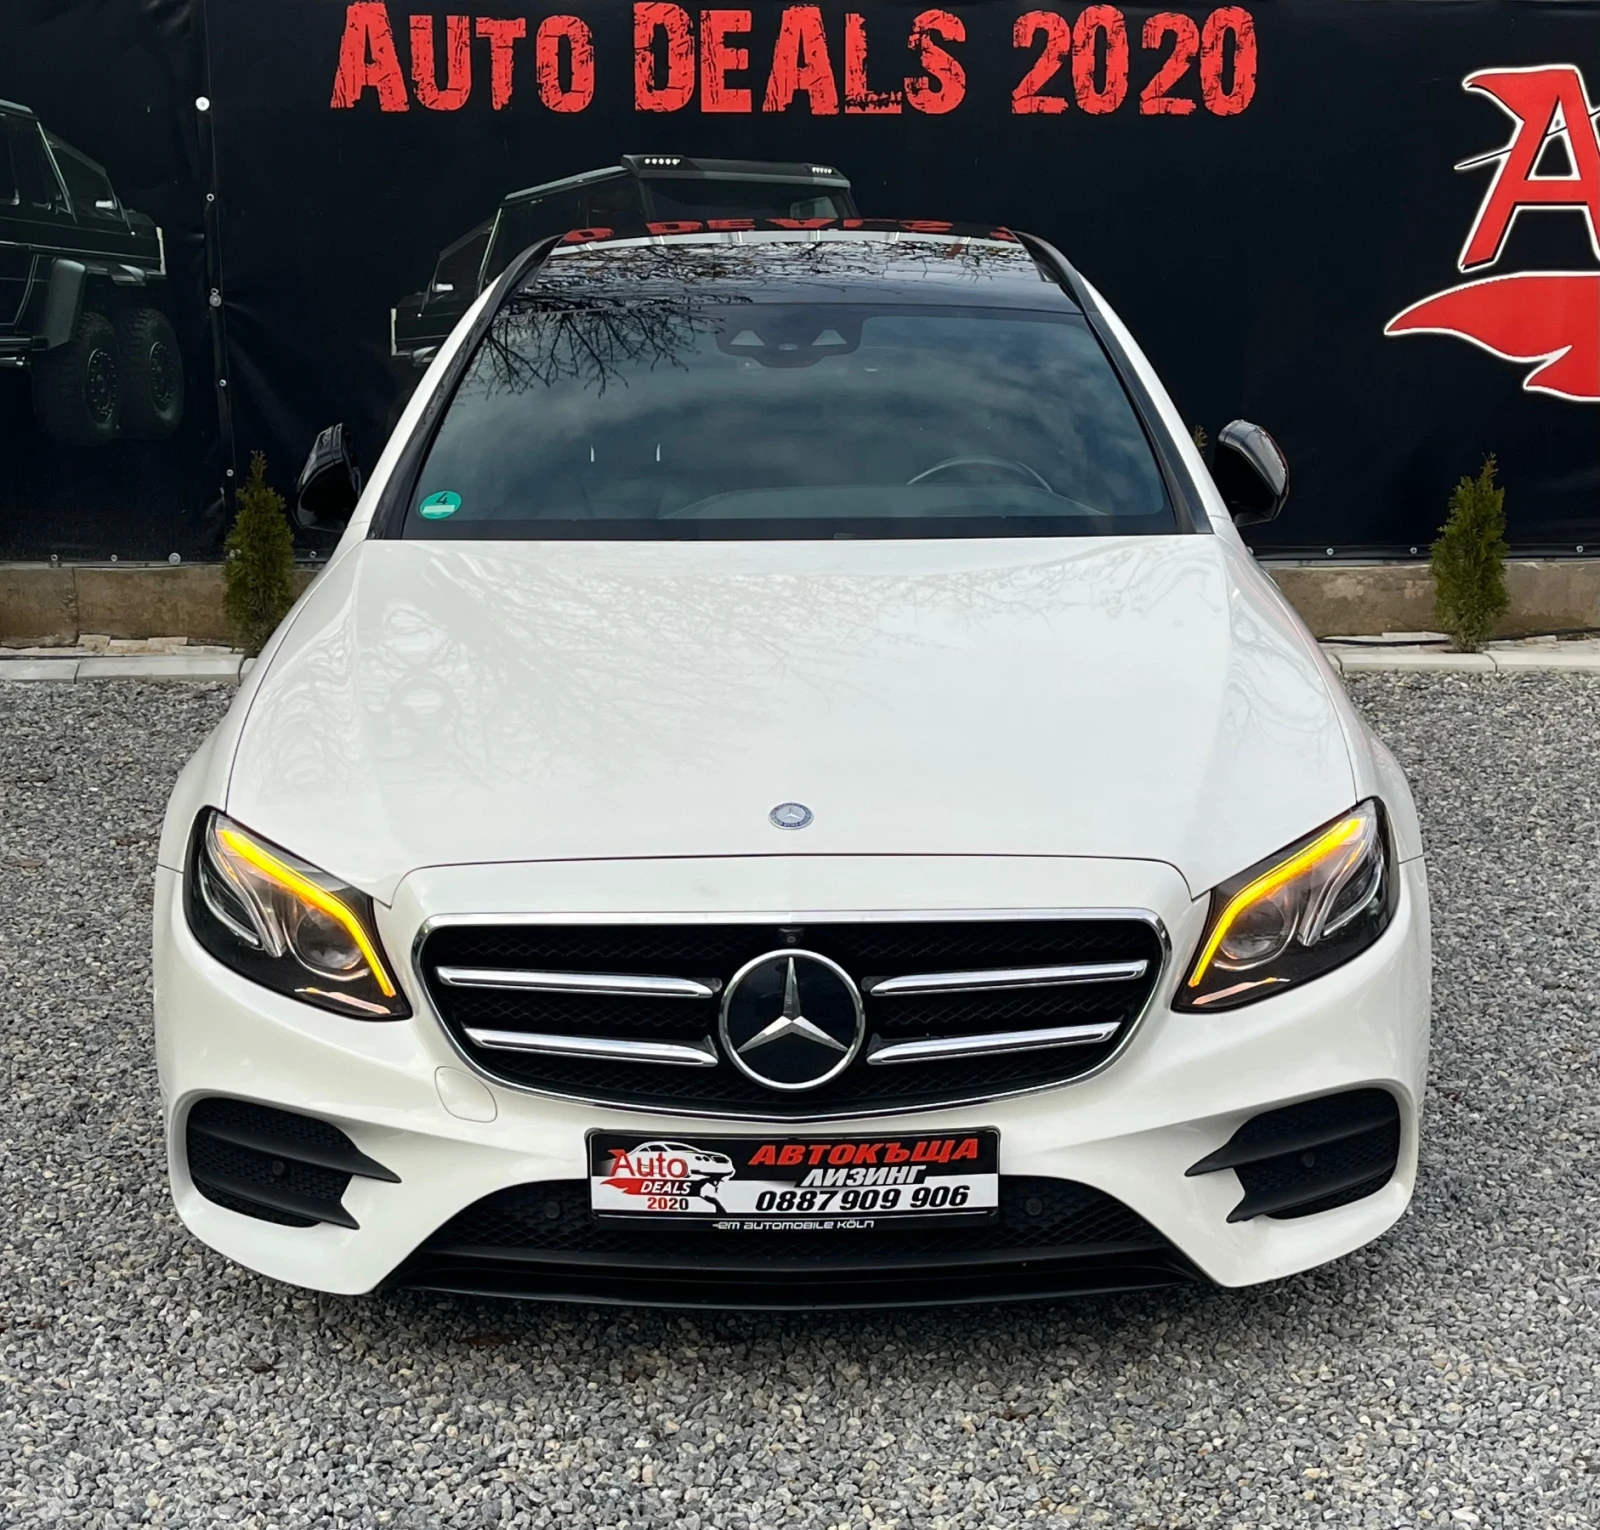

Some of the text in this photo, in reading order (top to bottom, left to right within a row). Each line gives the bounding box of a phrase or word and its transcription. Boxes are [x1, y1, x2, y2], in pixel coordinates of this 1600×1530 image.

[330, 1, 1257, 115] AUTO DEALS 2020
[435, 491, 449, 505] 4
[607, 1149, 689, 1178] Auto
[747, 1138, 979, 1166] АВТОКЪЩА
[640, 1181, 692, 1195] DEALS
[800, 1165, 927, 1188] ЛИЗИНГ
[647, 1197, 690, 1211] 2020
[755, 1185, 970, 1212] 0887 909 906
